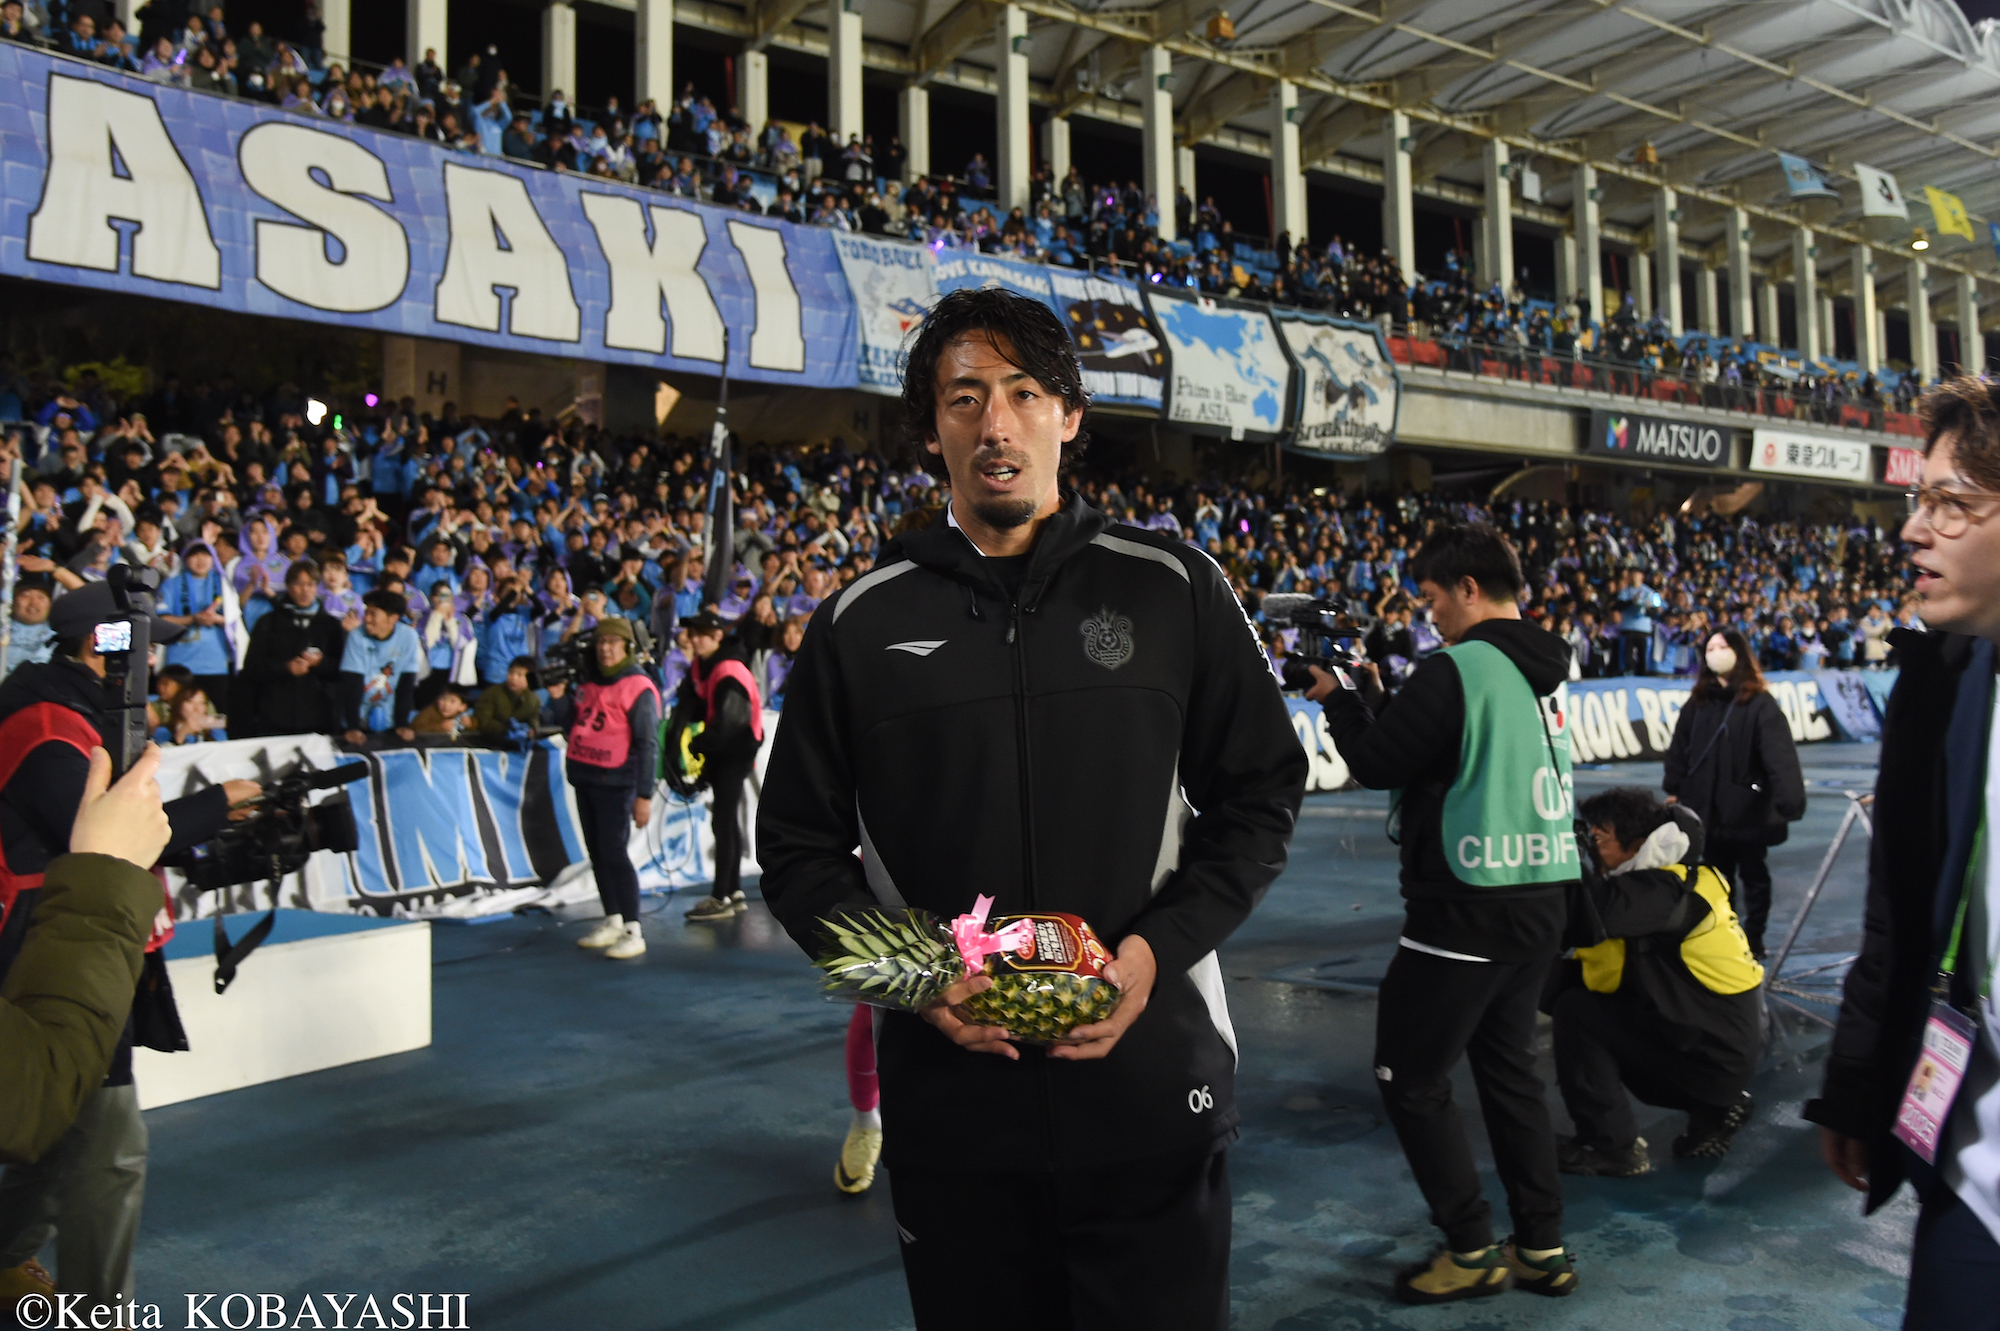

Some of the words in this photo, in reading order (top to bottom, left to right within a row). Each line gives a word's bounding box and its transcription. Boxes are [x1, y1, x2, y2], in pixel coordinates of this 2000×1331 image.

[26, 71, 806, 373] ASAKI
[1636, 420, 1722, 462] MATSUO
[1457, 832, 1551, 869] CLUB
[1187, 1084, 1214, 1114] 06
